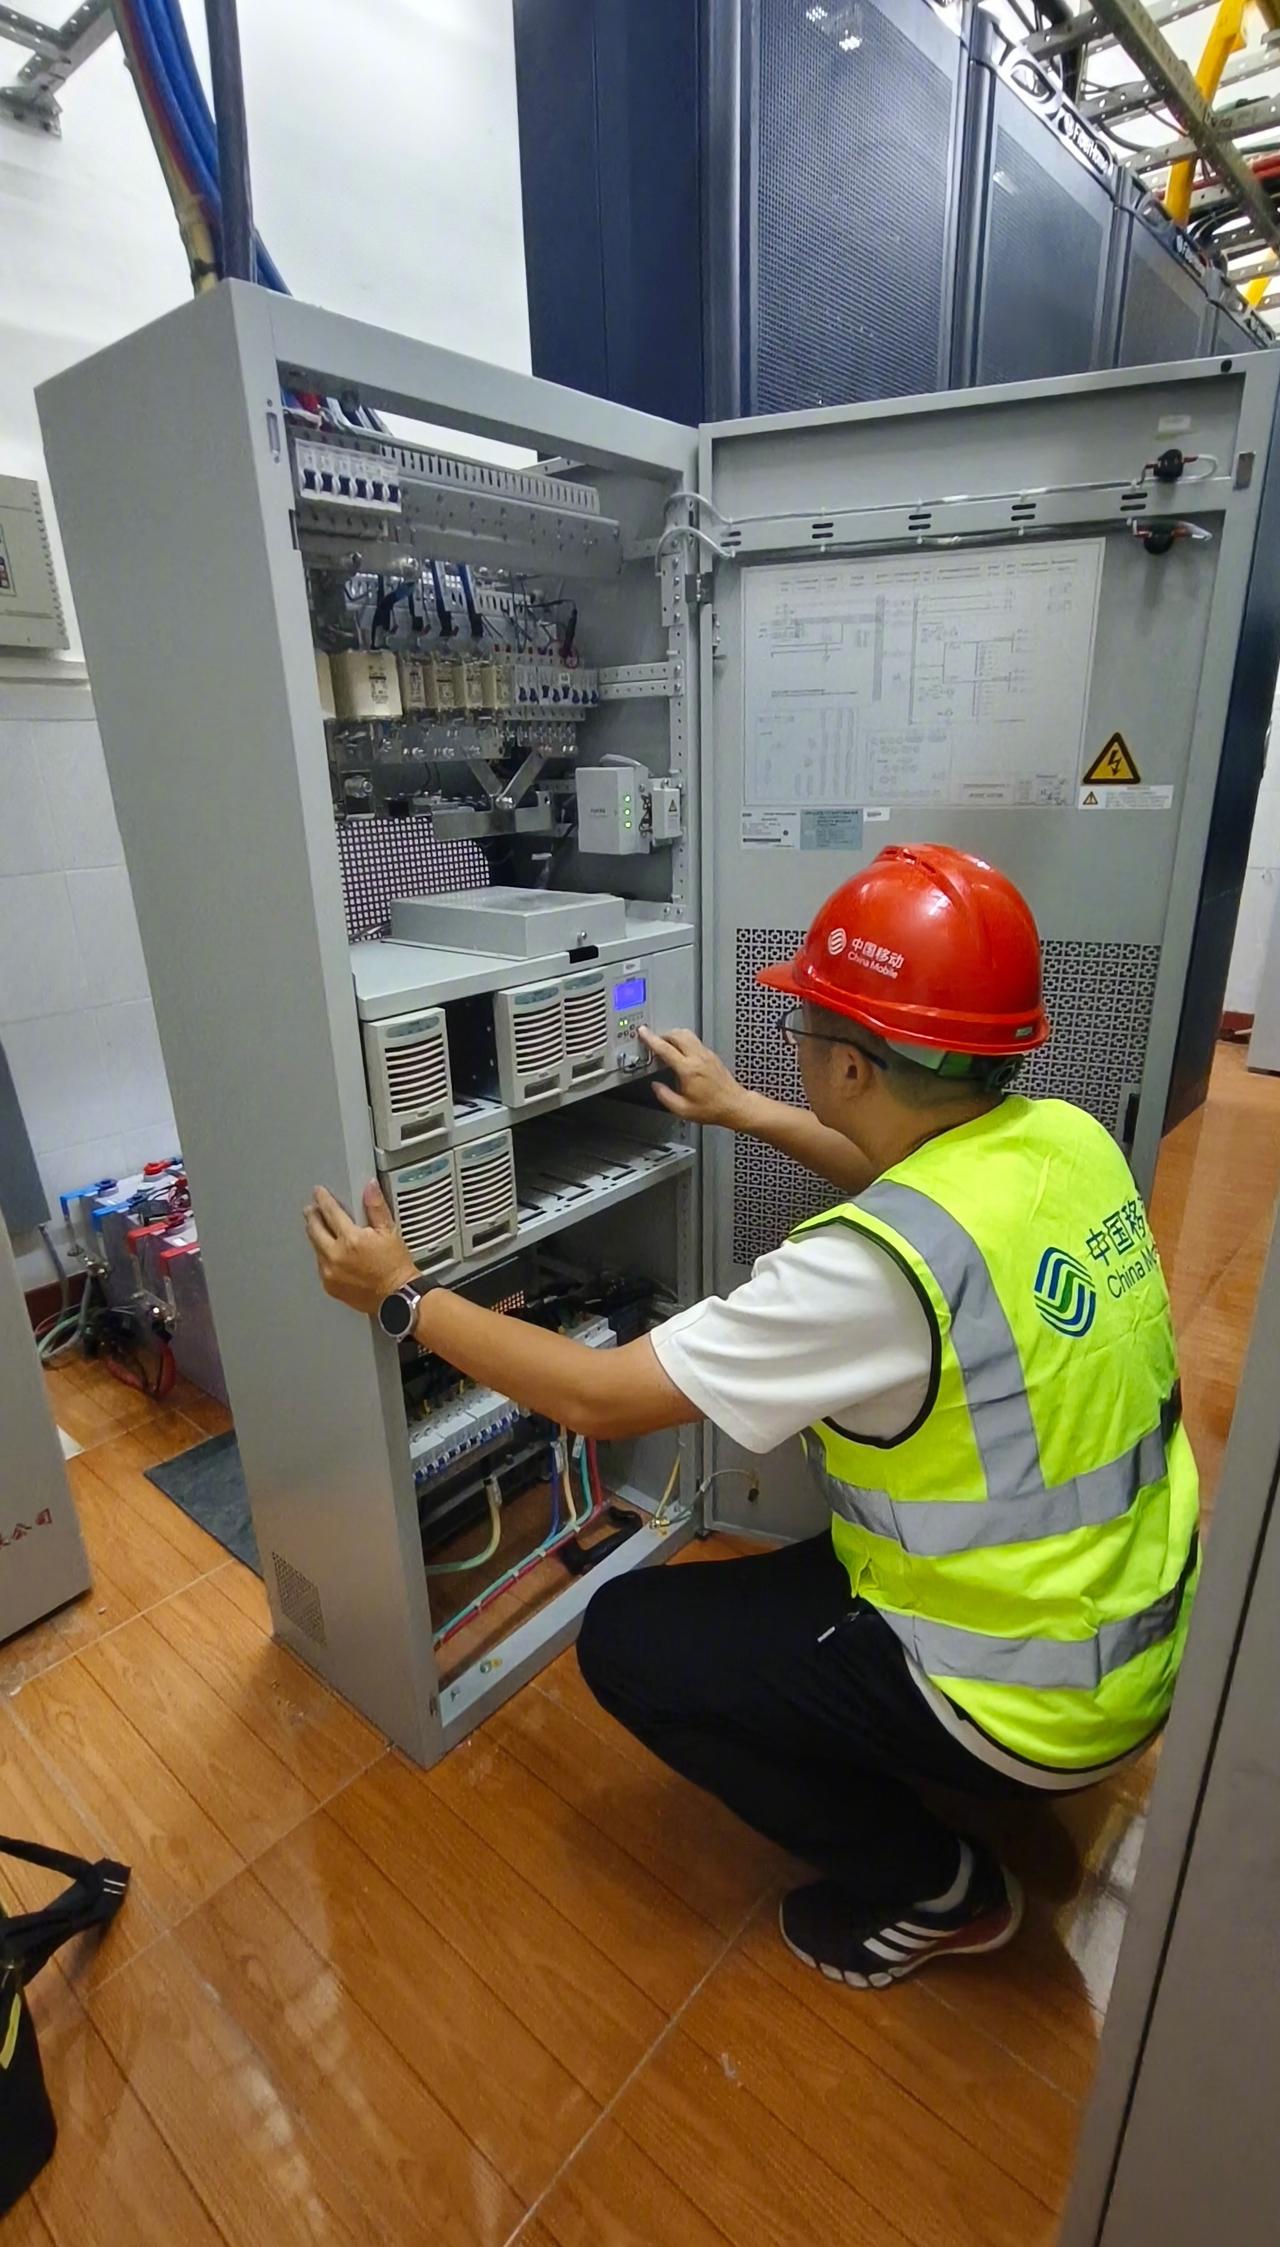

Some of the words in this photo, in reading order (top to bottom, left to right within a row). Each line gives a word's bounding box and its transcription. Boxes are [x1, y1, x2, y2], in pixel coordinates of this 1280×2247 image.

[848, 951, 870, 967] China
[870, 961, 898, 979] Mobile
[851, 937, 904, 968] 中国移动
[1086, 1197, 1146, 1266] 中国移
[1107, 1261, 1146, 1298] China
